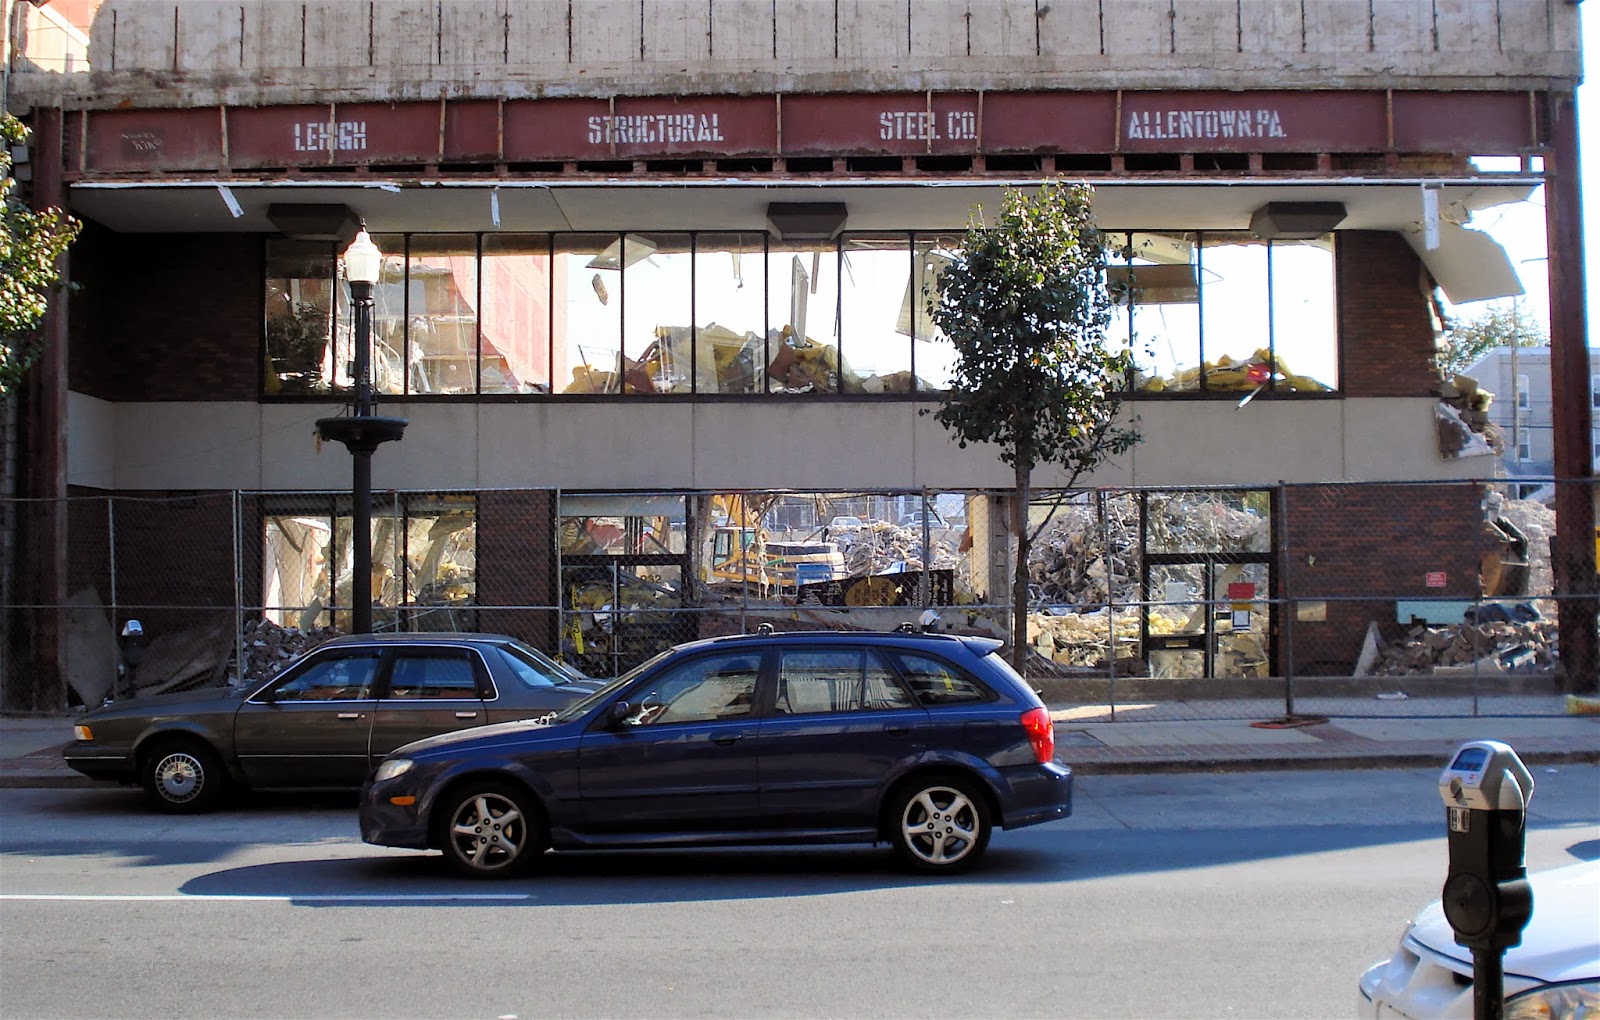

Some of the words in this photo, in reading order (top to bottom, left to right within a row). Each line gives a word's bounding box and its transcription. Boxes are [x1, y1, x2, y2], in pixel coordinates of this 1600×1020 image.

[294, 121, 367, 151] LEHIGH
[588, 113, 724, 144] STRUCTURAL
[880, 111, 941, 139] STEEL
